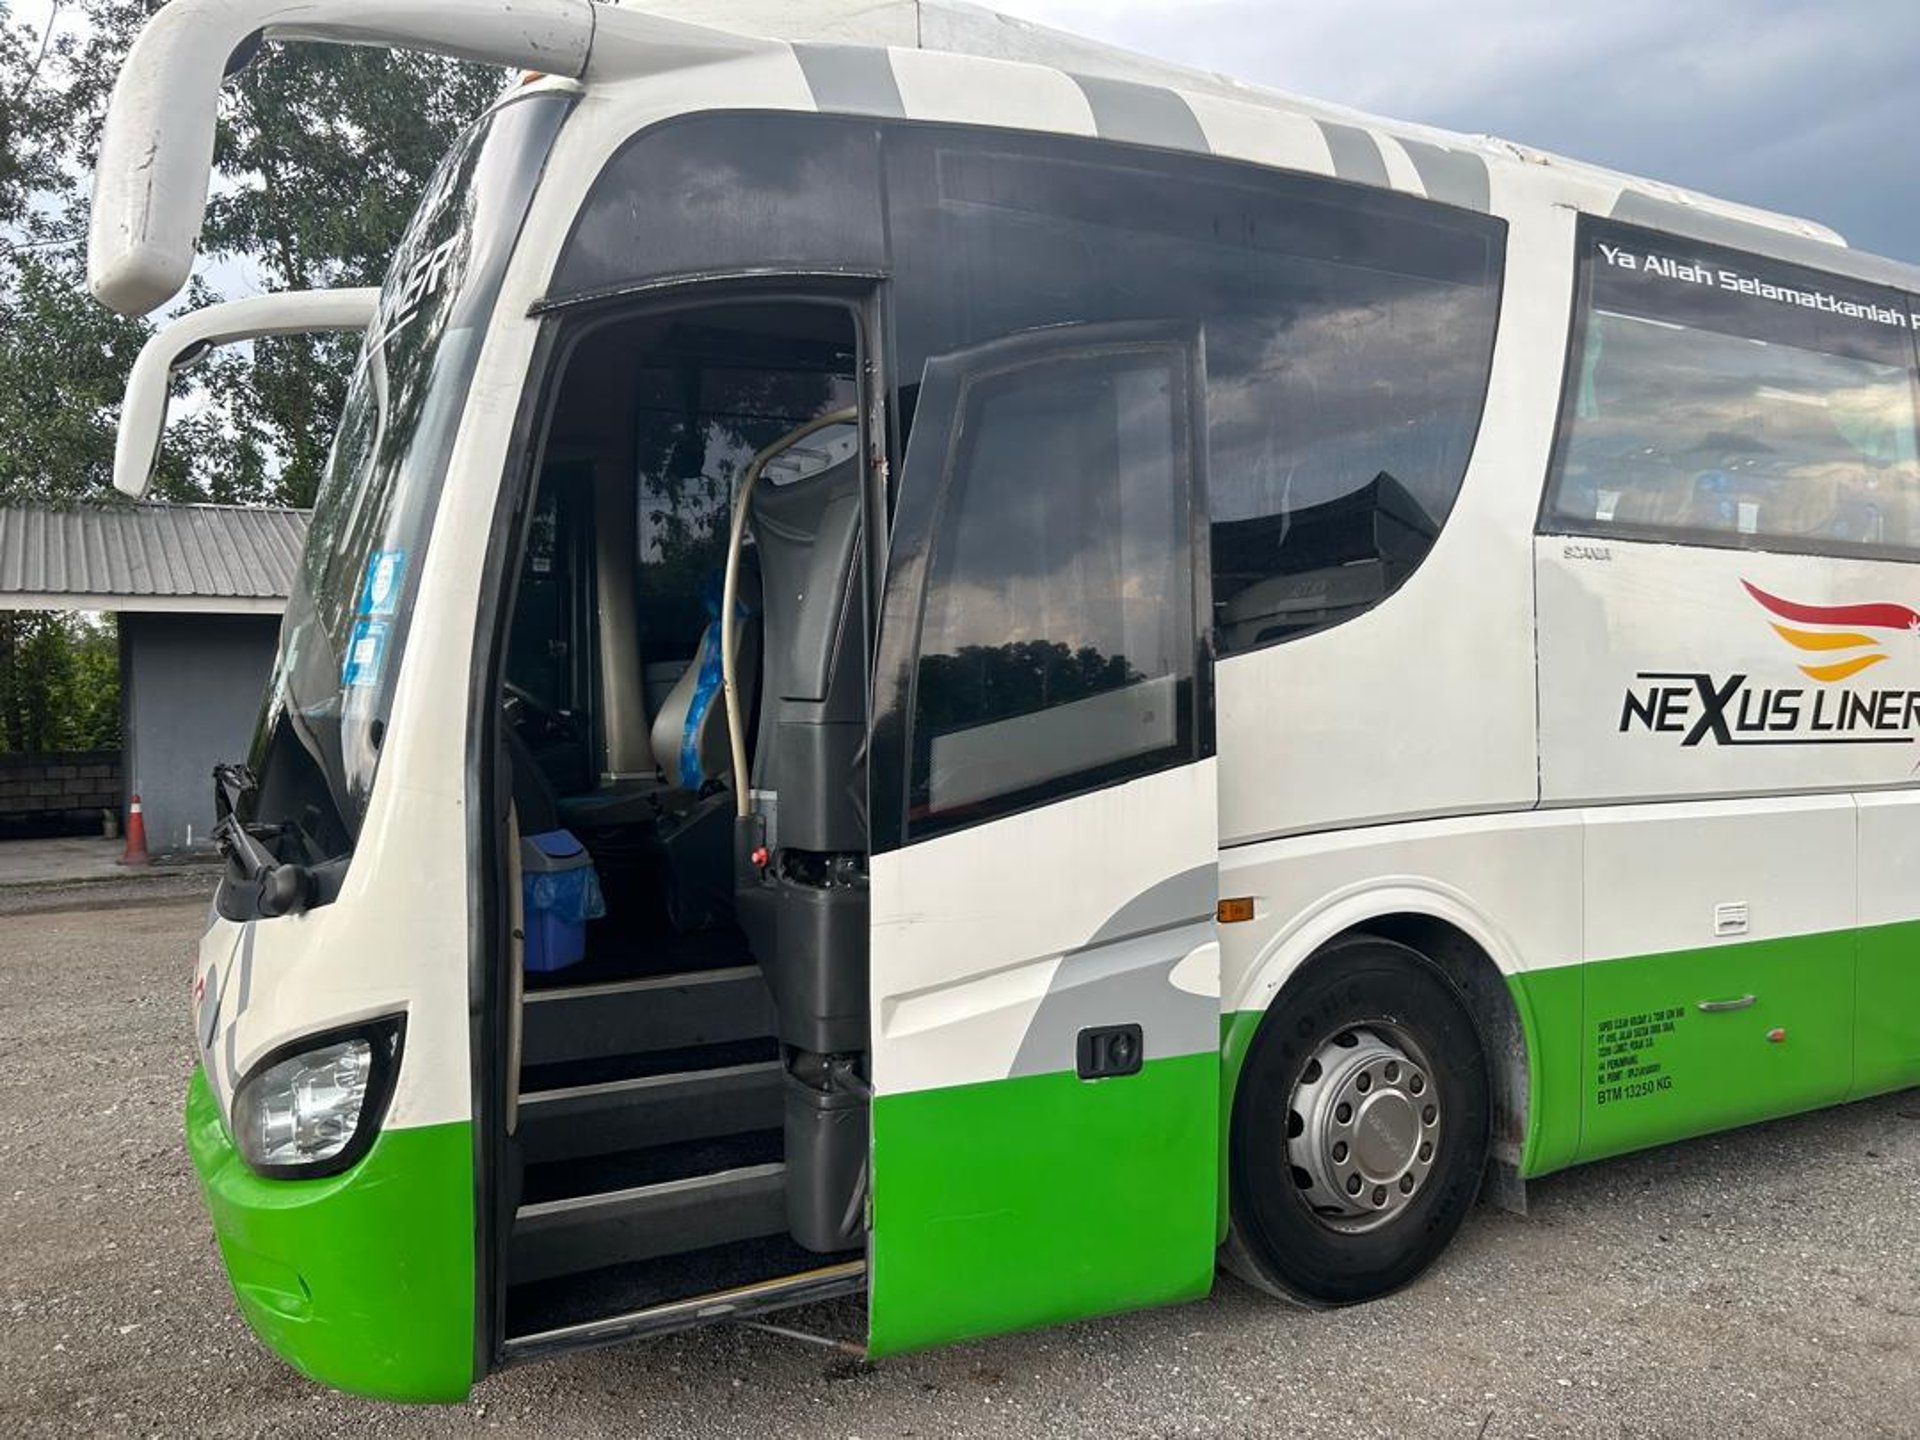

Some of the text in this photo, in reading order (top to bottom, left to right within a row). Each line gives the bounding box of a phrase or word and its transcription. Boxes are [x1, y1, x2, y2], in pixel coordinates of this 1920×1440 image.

[1598, 243, 1637, 269] Ya
[1643, 255, 1713, 286] Allah
[1718, 270, 1907, 328] Selamatkanlah
[1618, 673, 1920, 747] NEXUS LINER
[1597, 1075, 1672, 1105] BTM 13250 KG
